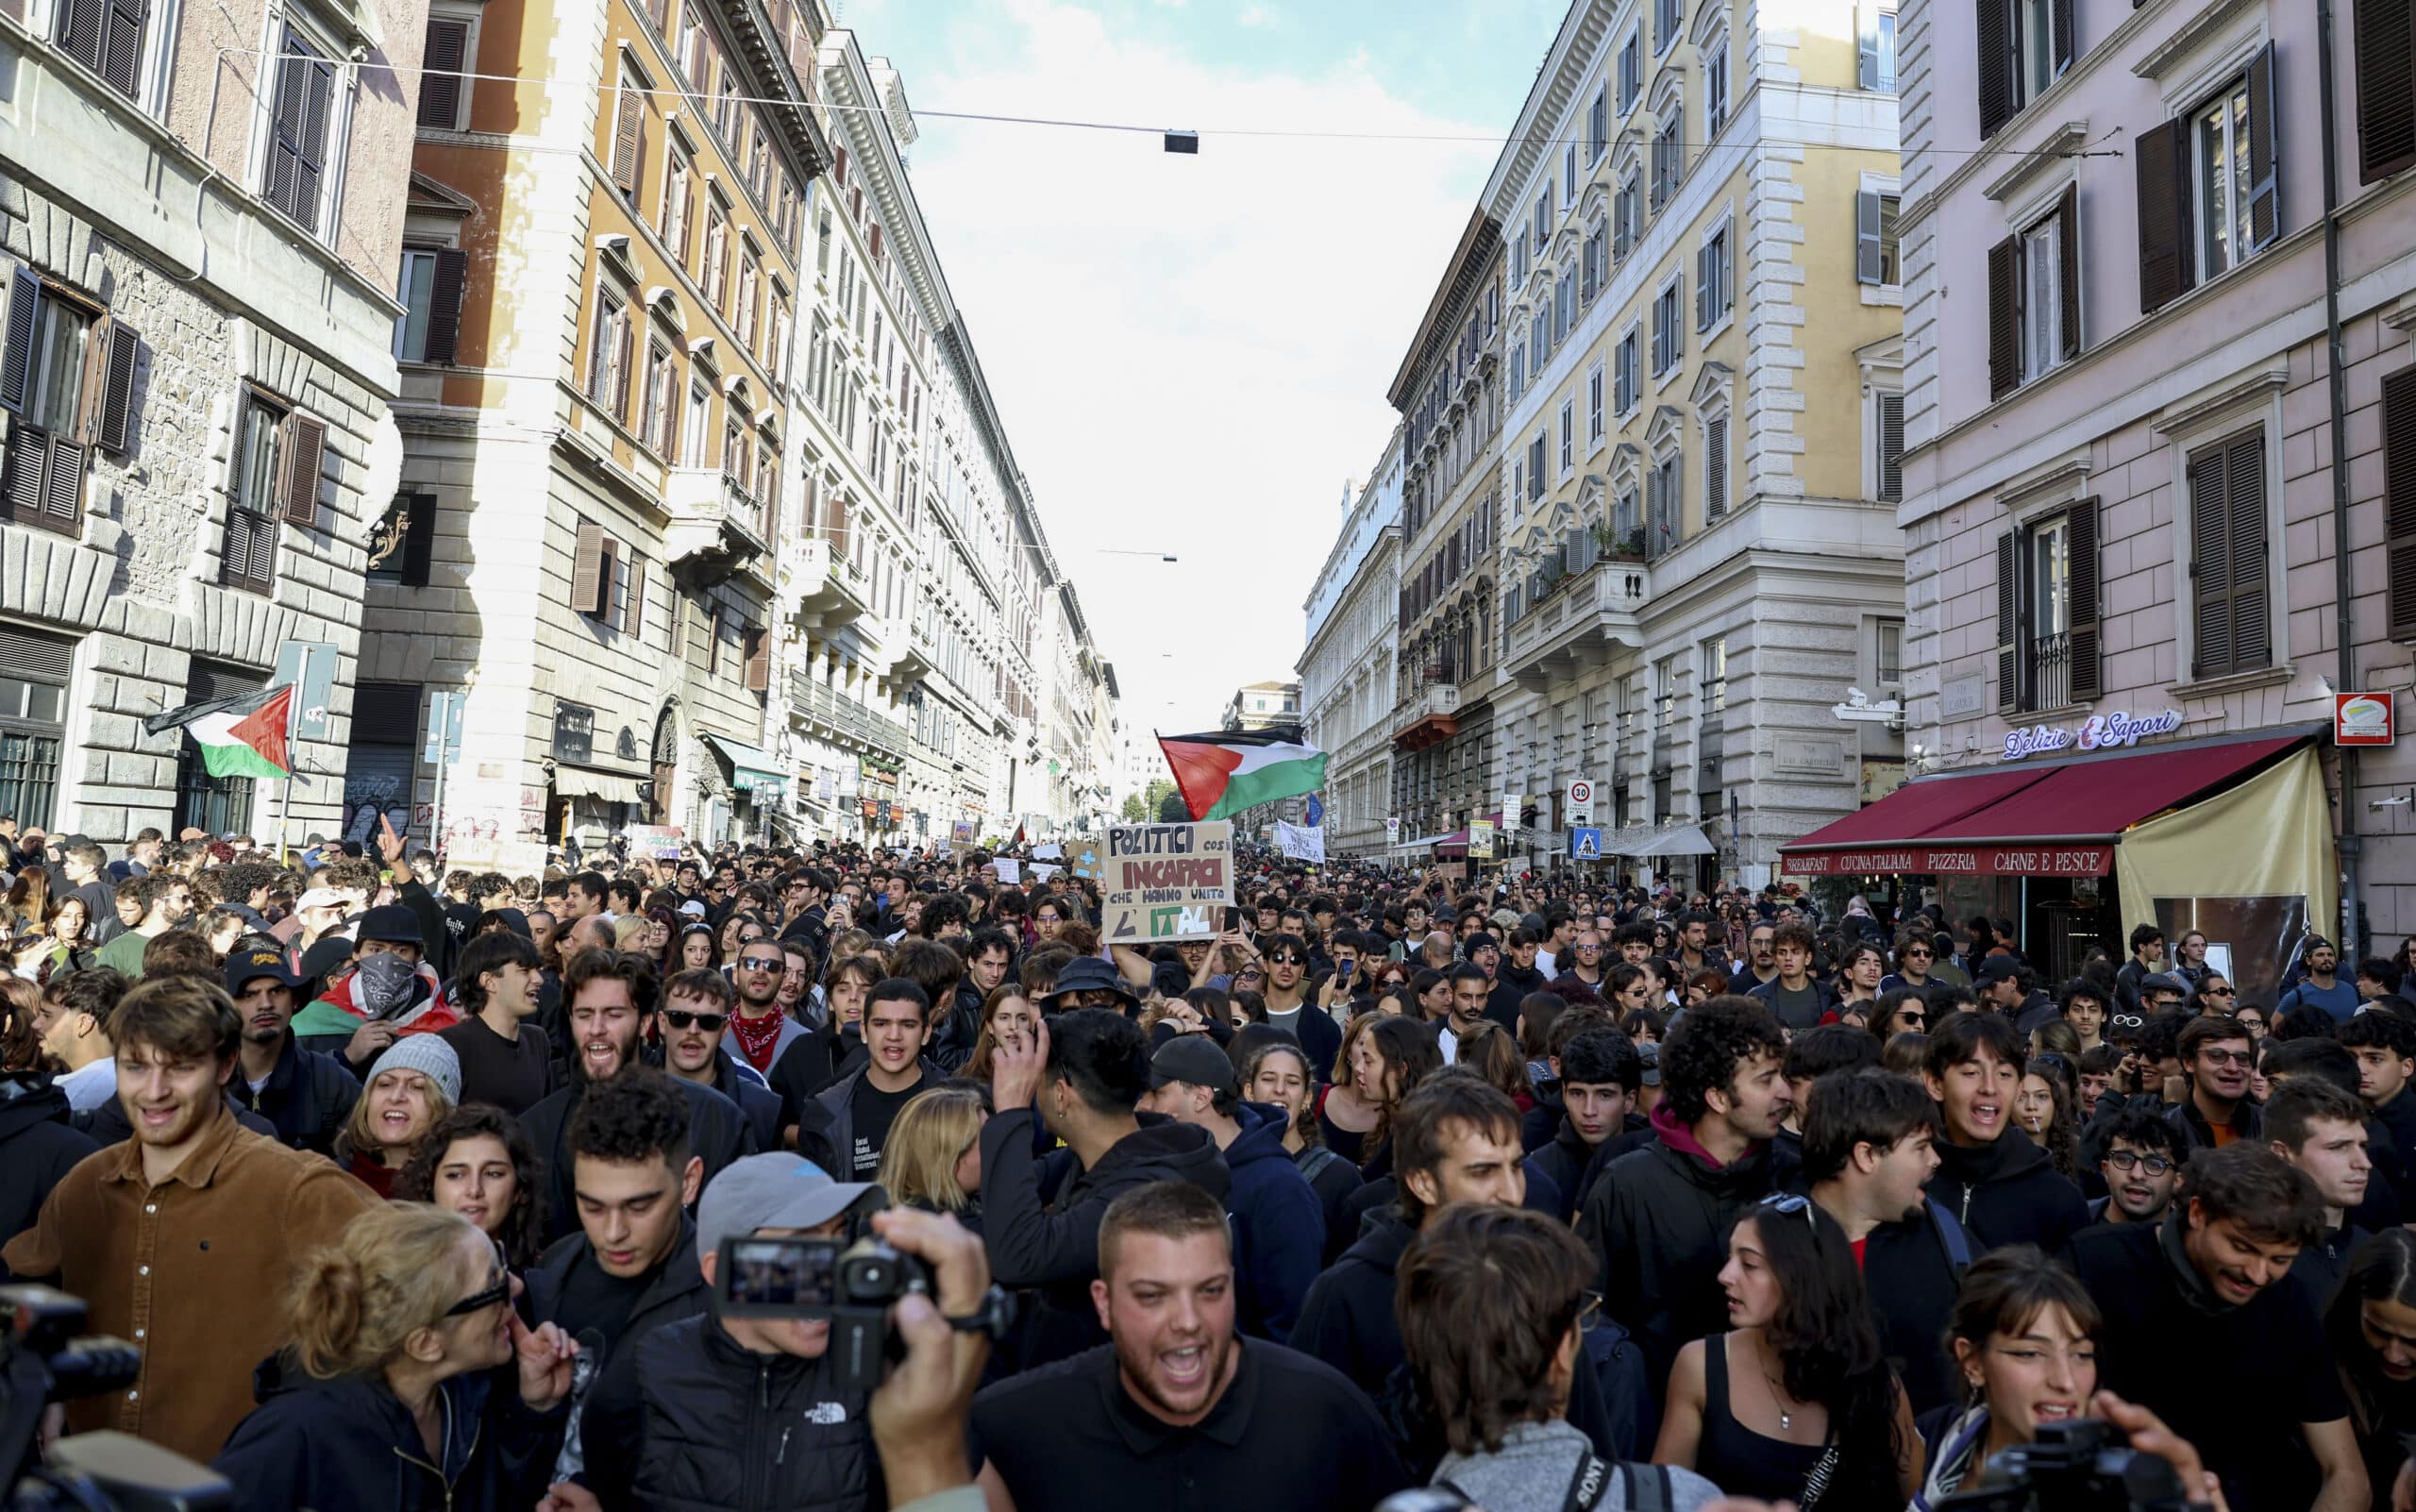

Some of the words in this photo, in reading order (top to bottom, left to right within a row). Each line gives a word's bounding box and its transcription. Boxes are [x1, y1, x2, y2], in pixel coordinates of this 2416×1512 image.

[2004, 725, 2070, 758] Delizie
[2102, 711, 2175, 745] Sapori
[1575, 788, 1586, 798] 30
[1109, 826, 1195, 857] POLITICI
[1122, 858, 1223, 890] INCAPACI
[1787, 856, 1829, 872] BREAKFAST
[1927, 852, 1976, 870] PIZZERIA
[1993, 851, 2038, 871] CARNE
[2041, 851, 2051, 871] E
[2055, 851, 2101, 872] PESCE
[1109, 892, 1133, 904] CHE
[1142, 889, 1183, 903] HANNO
[1191, 888, 1225, 900] UNITO
[1576, 1455, 1606, 1509] SONY
